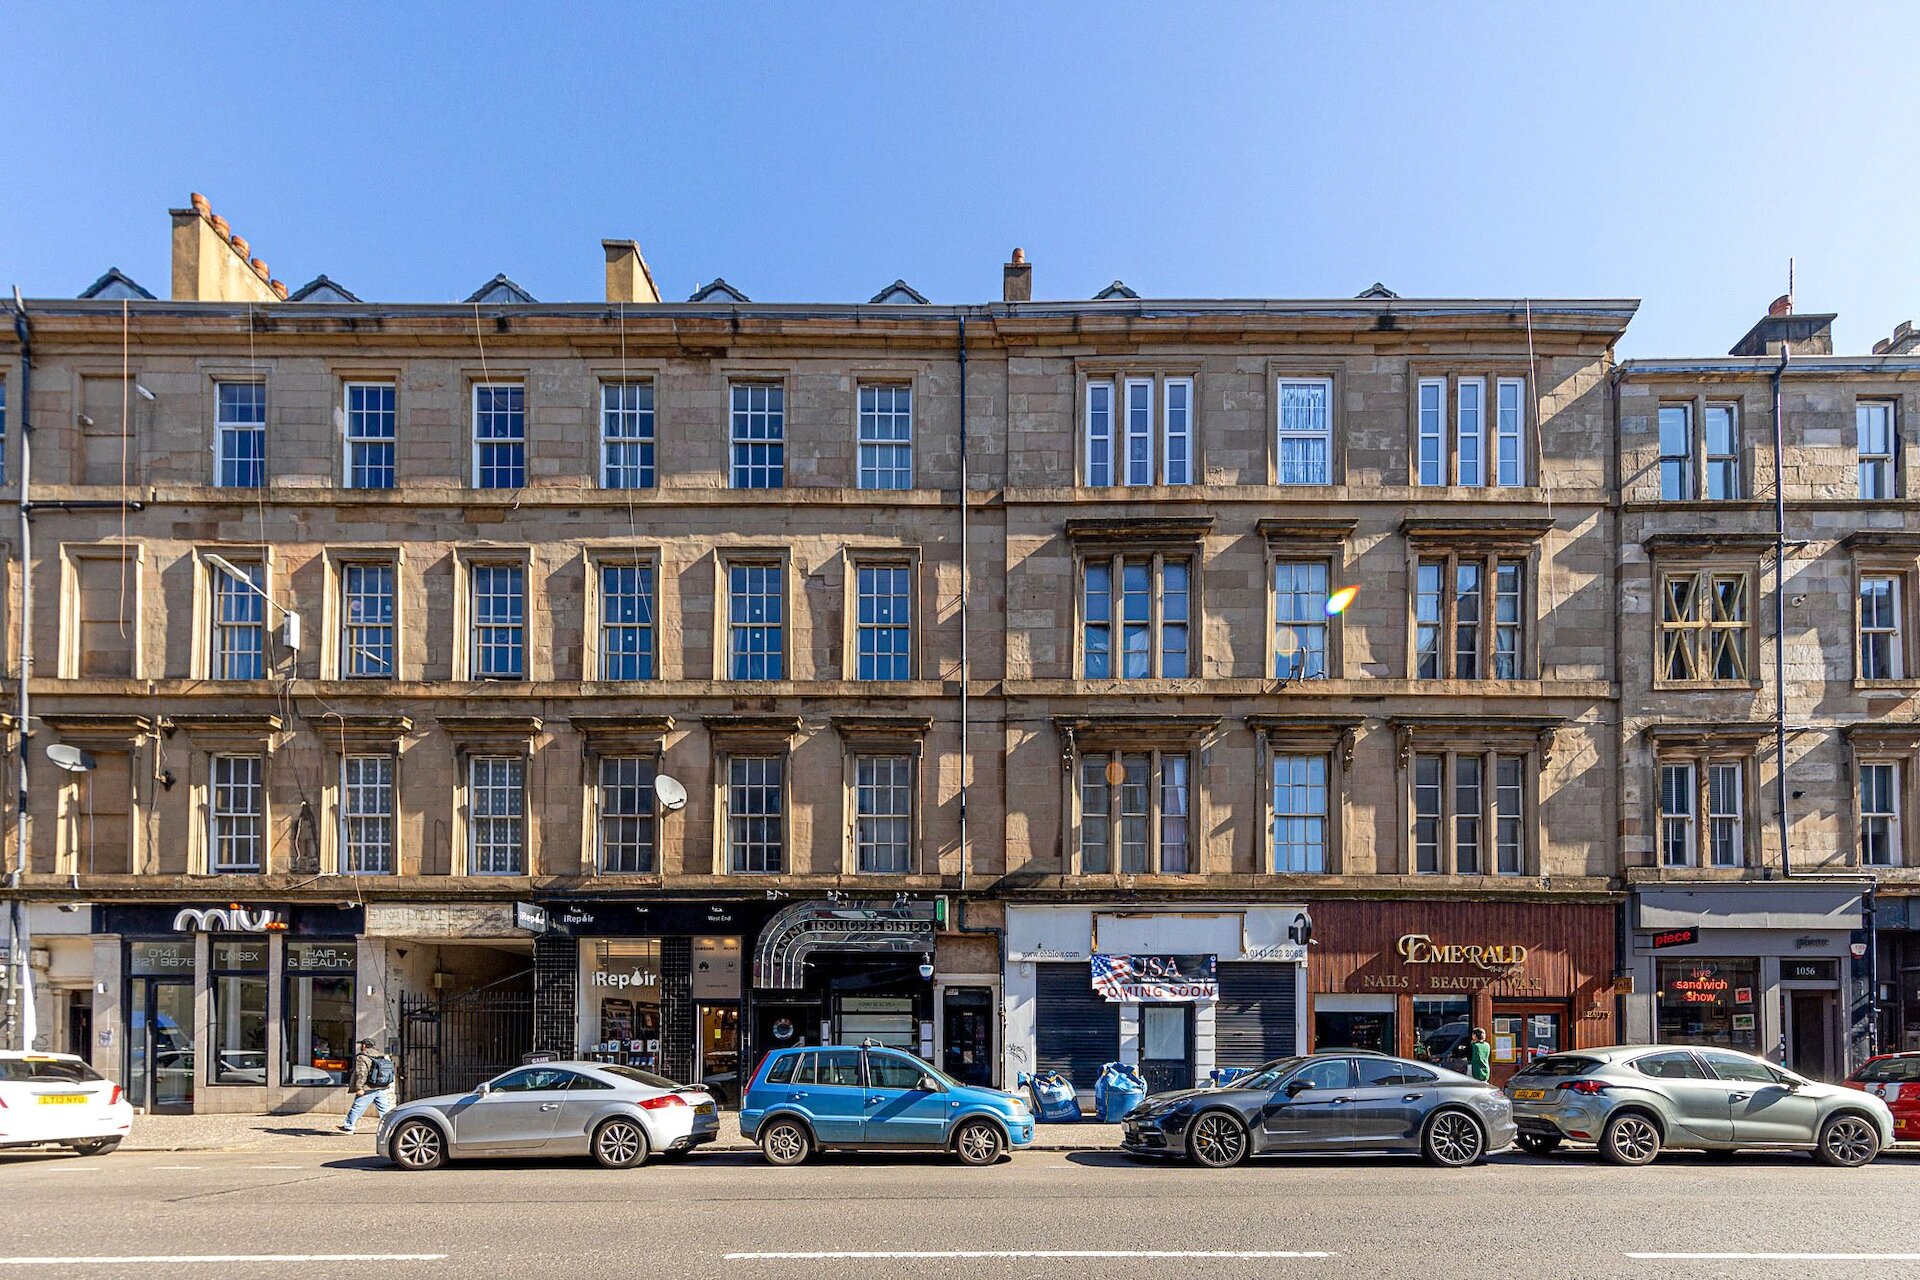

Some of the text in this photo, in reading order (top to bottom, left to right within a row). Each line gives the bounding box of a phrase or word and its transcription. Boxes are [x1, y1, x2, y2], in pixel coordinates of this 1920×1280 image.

[883, 921, 931, 932] BISTRO
[1655, 931, 1691, 948] piece
[148, 948, 177, 957] 0141
[220, 952, 259, 961] UNISEX
[305, 949, 336, 958] HAIR
[1250, 949, 1267, 958] 0141
[1398, 934, 1528, 970] EMERALD
[288, 958, 354, 967] & BEAUTY
[1130, 956, 1182, 978] USA
[1692, 967, 1711, 978] live
[1796, 967, 1816, 976] 1056
[1364, 975, 1409, 988] NAILS
[1431, 976, 1491, 989] BEAUTY
[1676, 978, 1728, 990] sandwich
[1098, 985, 1213, 998] COMING SOON
[1686, 991, 1716, 1002] show
